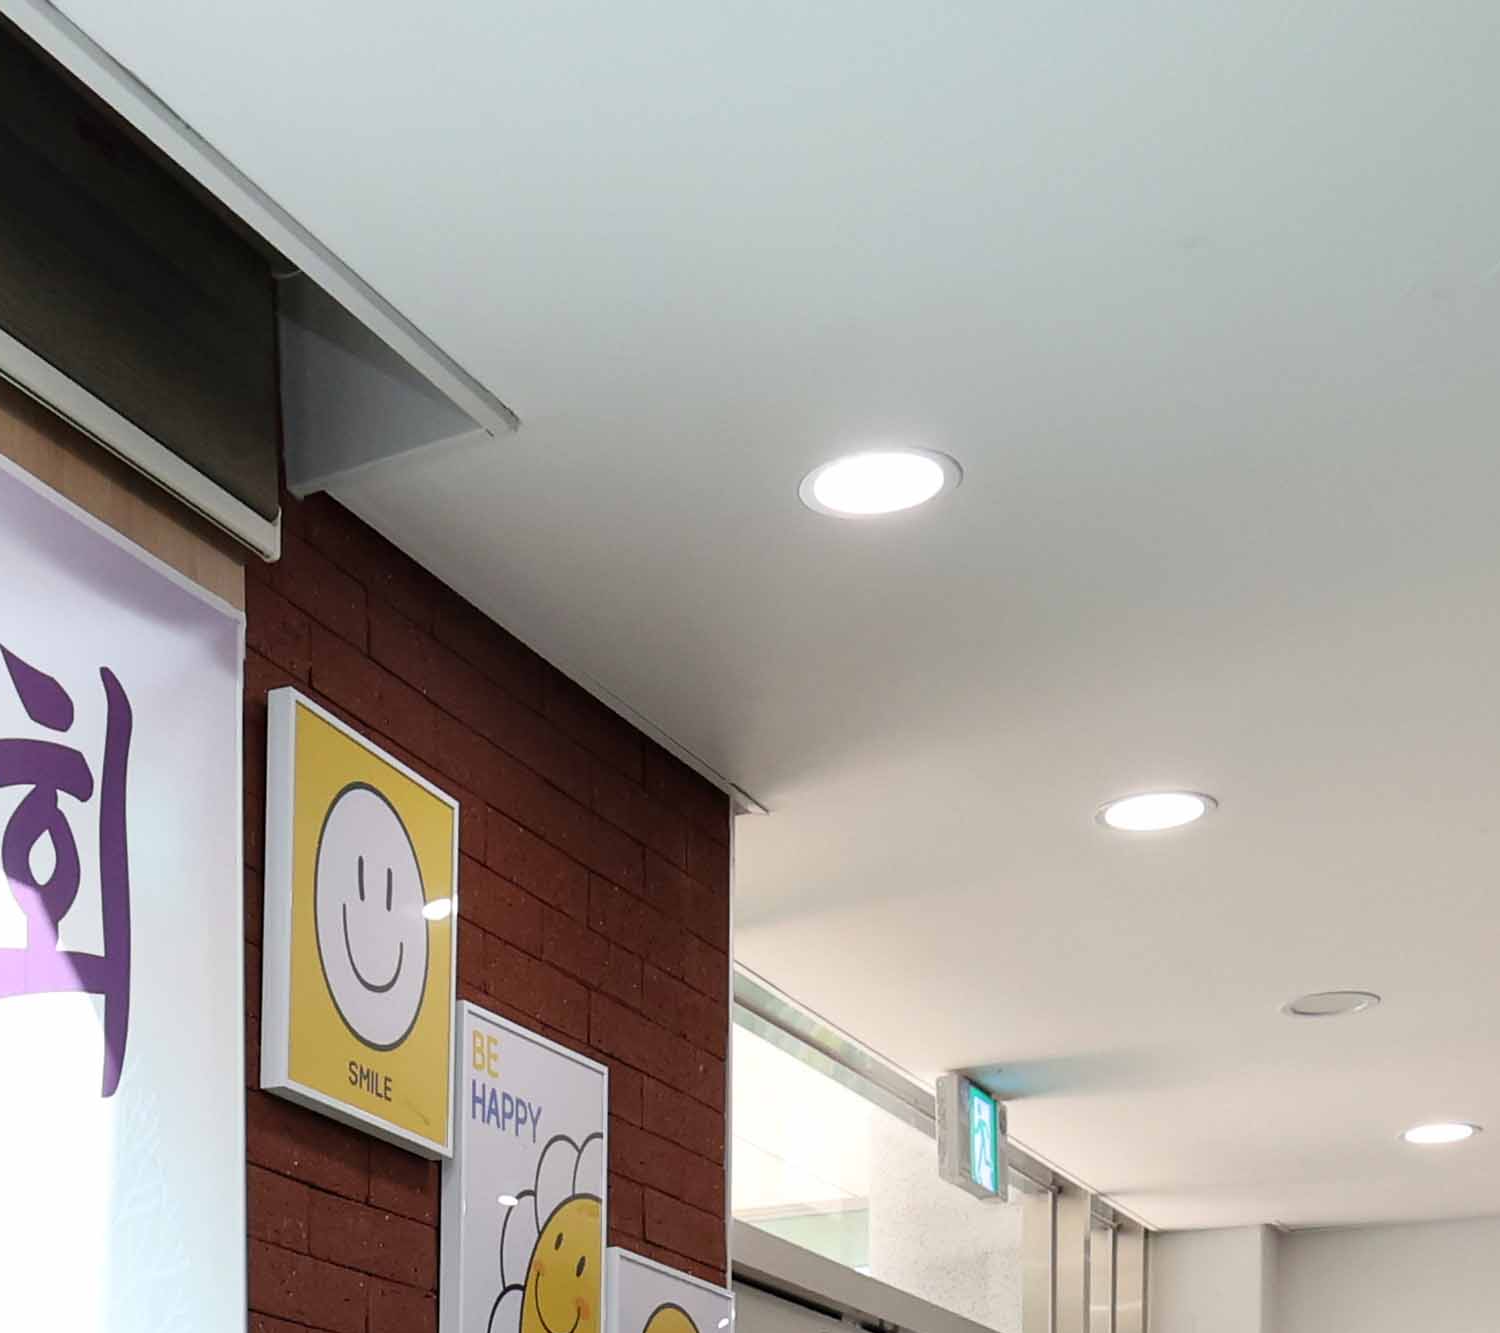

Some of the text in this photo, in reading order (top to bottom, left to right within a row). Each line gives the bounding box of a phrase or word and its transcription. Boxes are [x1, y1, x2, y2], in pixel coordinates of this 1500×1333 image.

[470, 1029, 500, 1079] BE
[347, 1060, 394, 1103] SMILE
[470, 1079, 542, 1144] HAPPY
